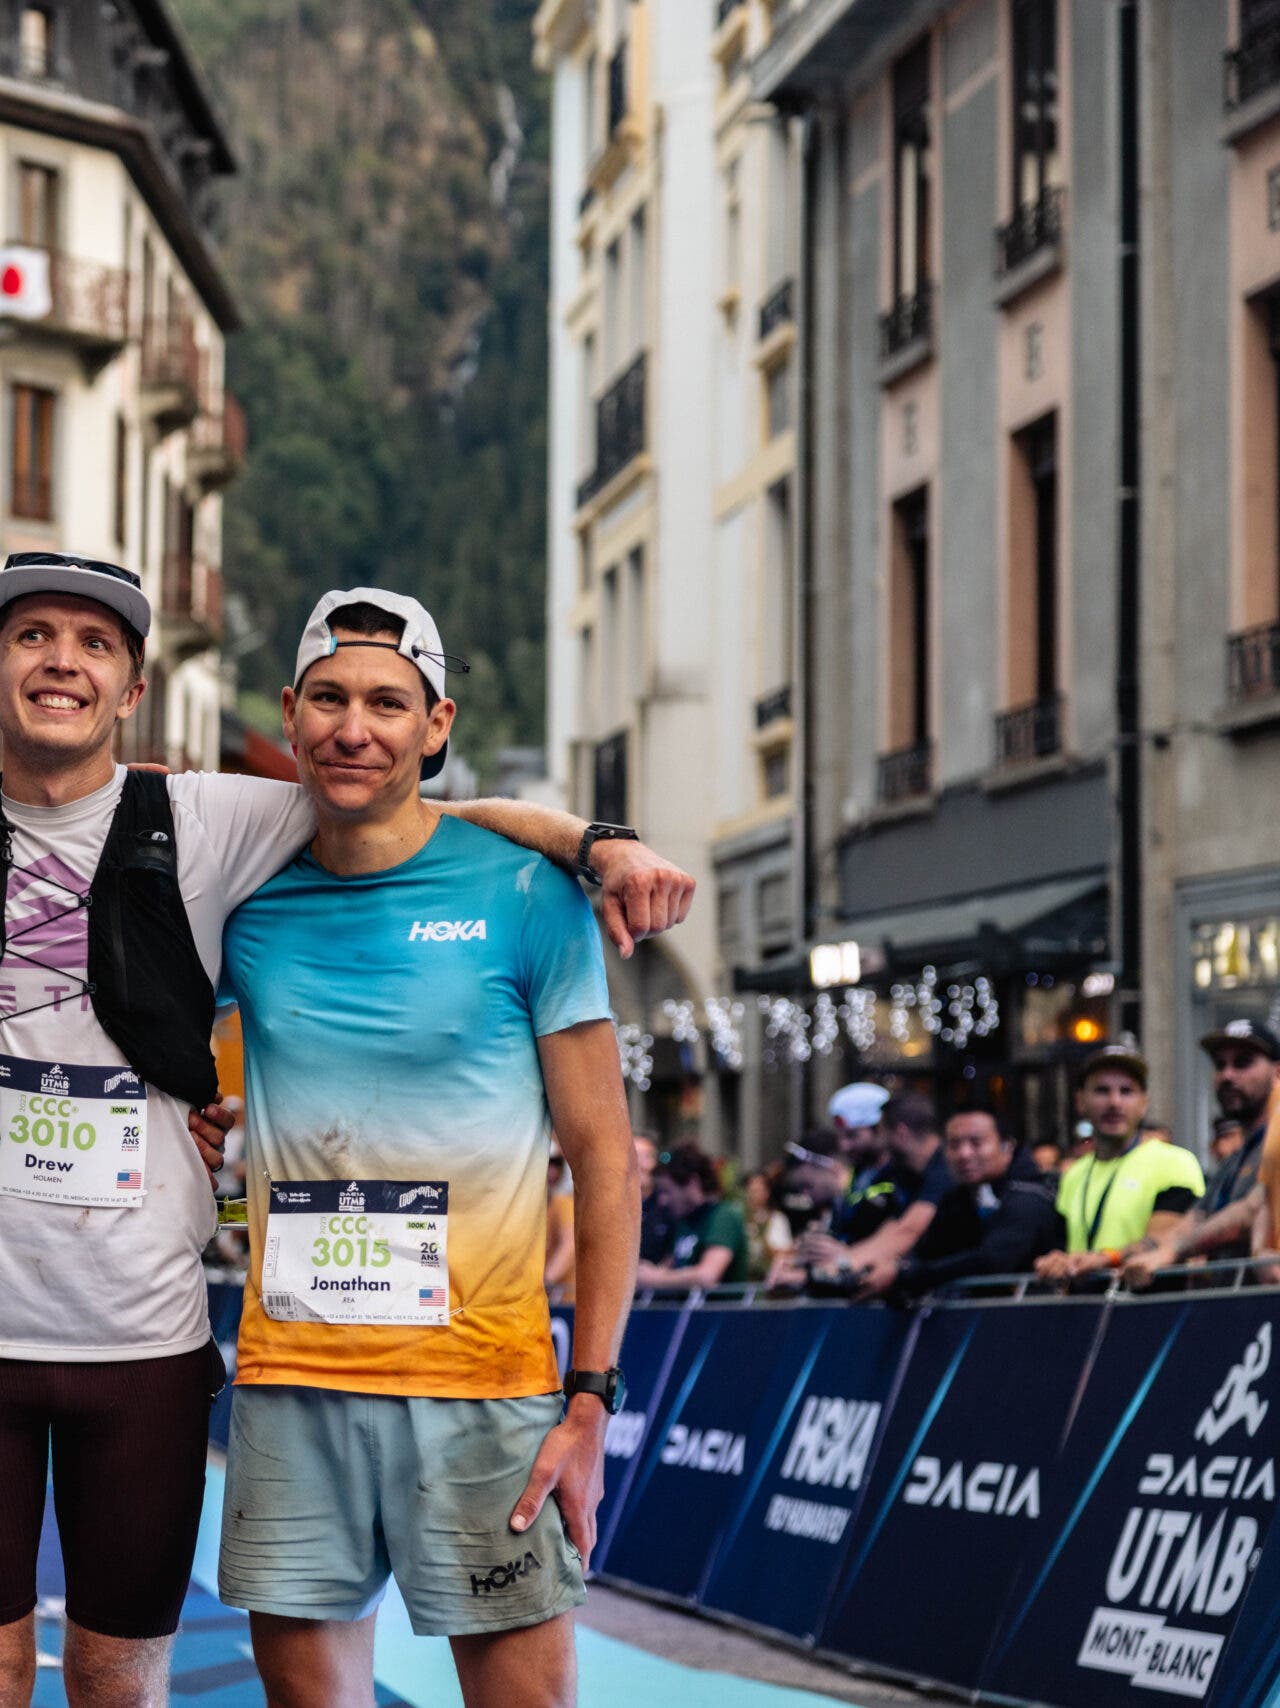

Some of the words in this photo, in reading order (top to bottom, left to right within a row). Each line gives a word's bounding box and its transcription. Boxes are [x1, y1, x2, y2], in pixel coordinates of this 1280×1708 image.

[408, 920, 486, 941] HOKA
[41, 1079, 69, 1088] UTMB
[9, 1115, 96, 1151] 3010
[123, 1126, 140, 1137] 20
[25, 1154, 74, 1172] Drew
[33, 1174, 62, 1184] HOLMEN
[339, 1197, 365, 1206] UTMB
[427, 1222, 436, 1230] M
[311, 1238, 392, 1268] 3015
[420, 1242, 438, 1253] 20
[310, 1276, 391, 1291] Jonathan
[660, 1423, 747, 1476] DACIA
[780, 1394, 882, 1491] HOKA
[903, 1455, 1041, 1519] DACIA
[1138, 1453, 1275, 1501] DACIA
[1105, 1506, 1258, 1616] UTMB
[470, 1551, 542, 1596] HOKA
